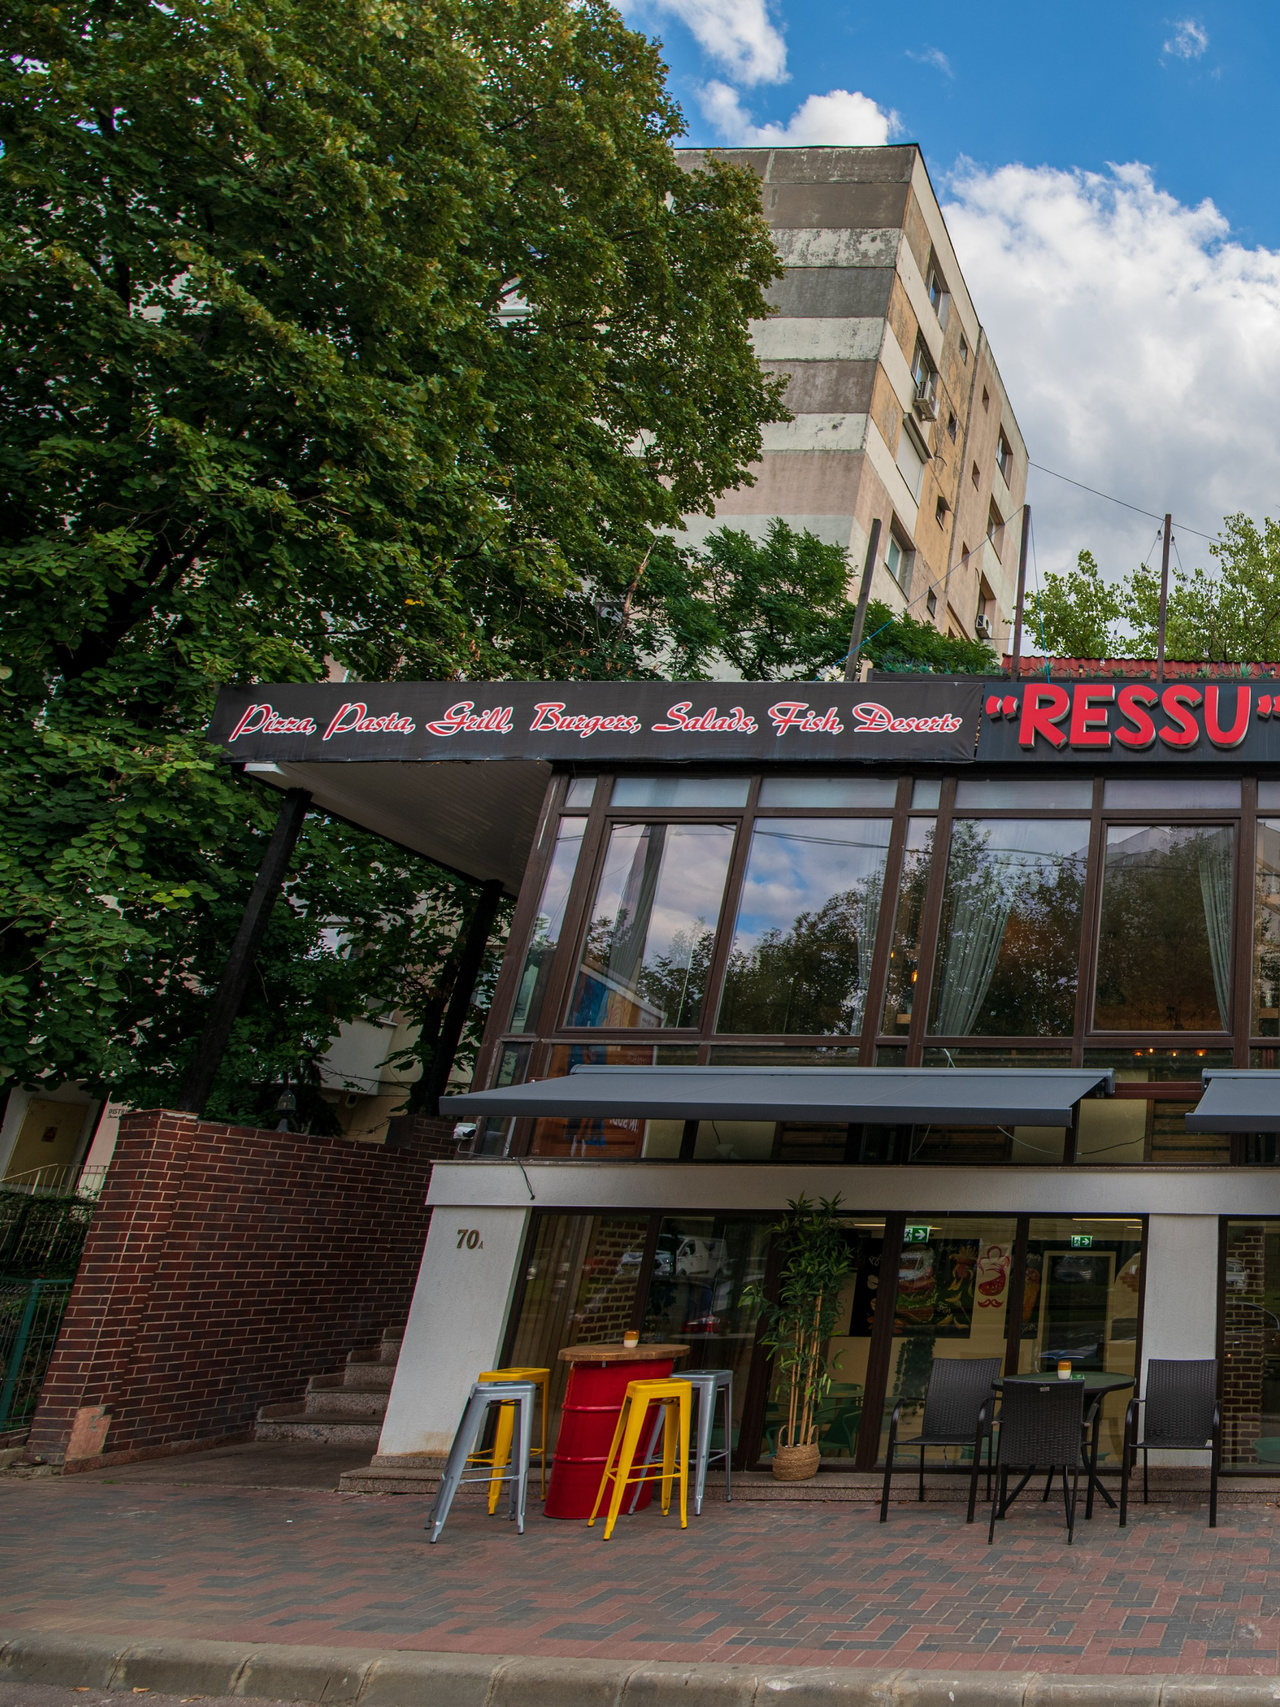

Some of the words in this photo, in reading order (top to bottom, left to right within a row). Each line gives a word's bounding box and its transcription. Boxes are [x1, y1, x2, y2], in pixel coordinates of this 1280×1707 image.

[228, 703, 317, 743] Pizza,
[322, 702, 416, 741] Pasta,
[425, 700, 514, 737] Grill,
[529, 702, 642, 739] Burgers,
[651, 701, 759, 735] Salads,
[767, 701, 845, 737] Fish,
[851, 702, 963, 733] Deserts
